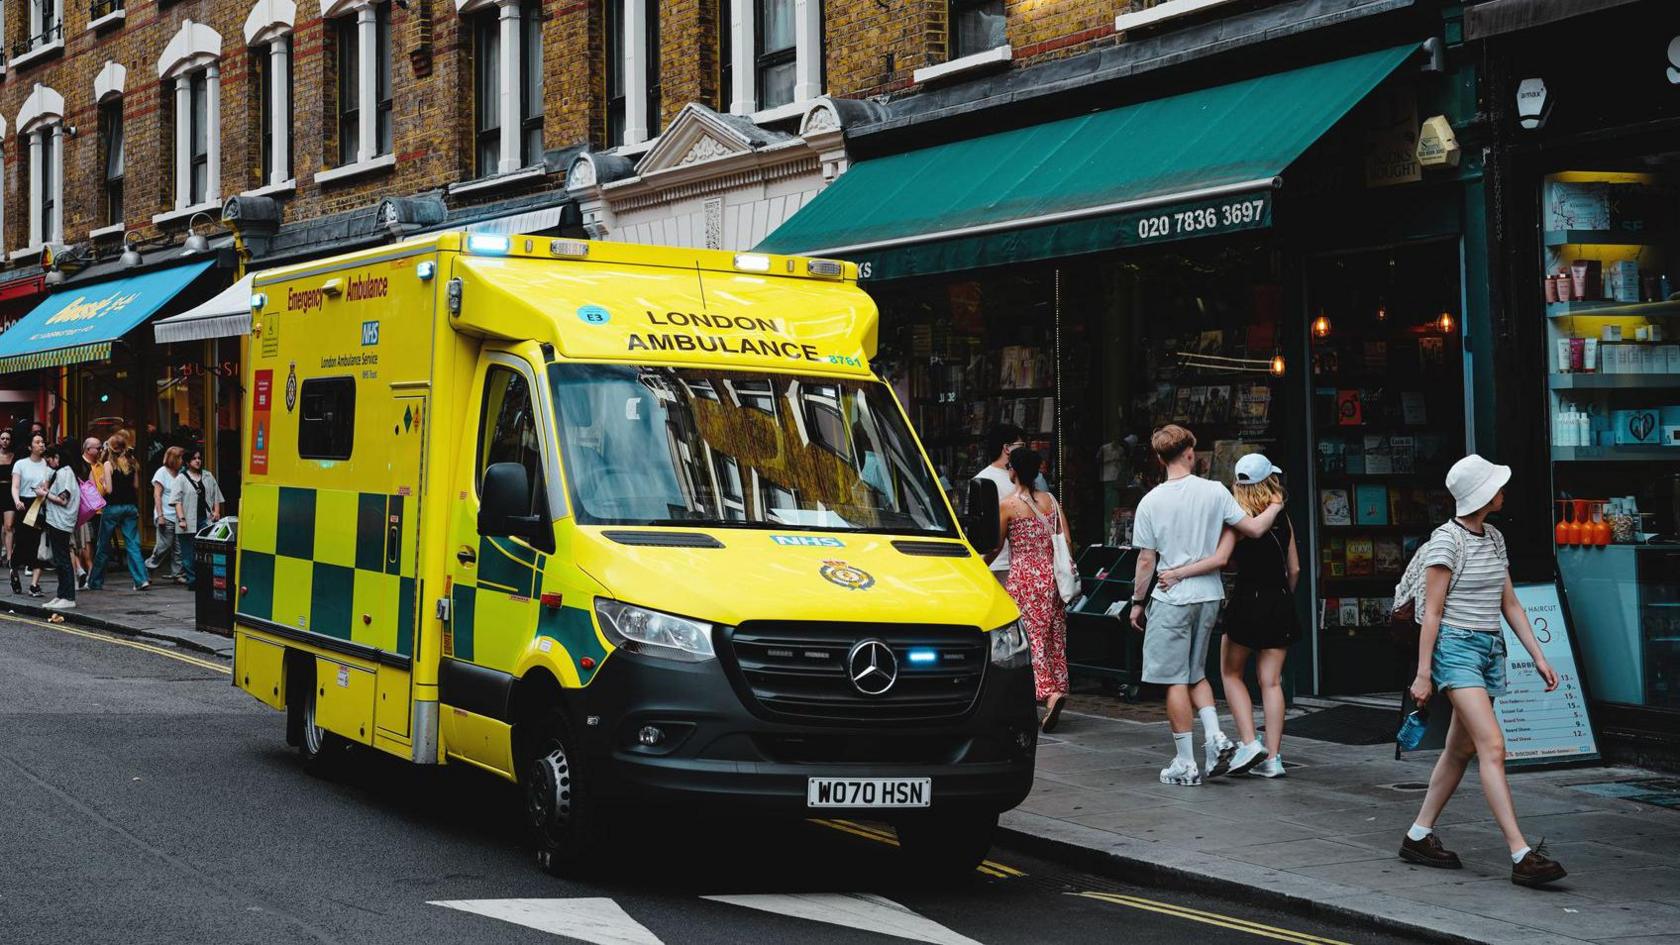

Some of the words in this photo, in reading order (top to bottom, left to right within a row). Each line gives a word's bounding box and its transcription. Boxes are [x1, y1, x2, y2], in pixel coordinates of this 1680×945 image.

[1138, 216, 1169, 239] 020
[1174, 207, 1217, 233] 7836
[1222, 200, 1264, 226] 3697
[287, 286, 324, 313] Emergency
[346, 273, 388, 302] Ambulance
[586, 313, 603, 322] E3
[646, 310, 781, 334] LONDON
[361, 321, 379, 346] NHS
[321, 356, 337, 369] London
[338, 354, 361, 367] Ambulance
[361, 352, 378, 366] Service
[627, 334, 819, 363] AMBULANCE
[773, 535, 842, 547] NHS
[1528, 604, 1557, 613] HAIRCUT
[1534, 617, 1551, 644] 3
[818, 781, 876, 804] WO70
[882, 781, 923, 804] HSN
